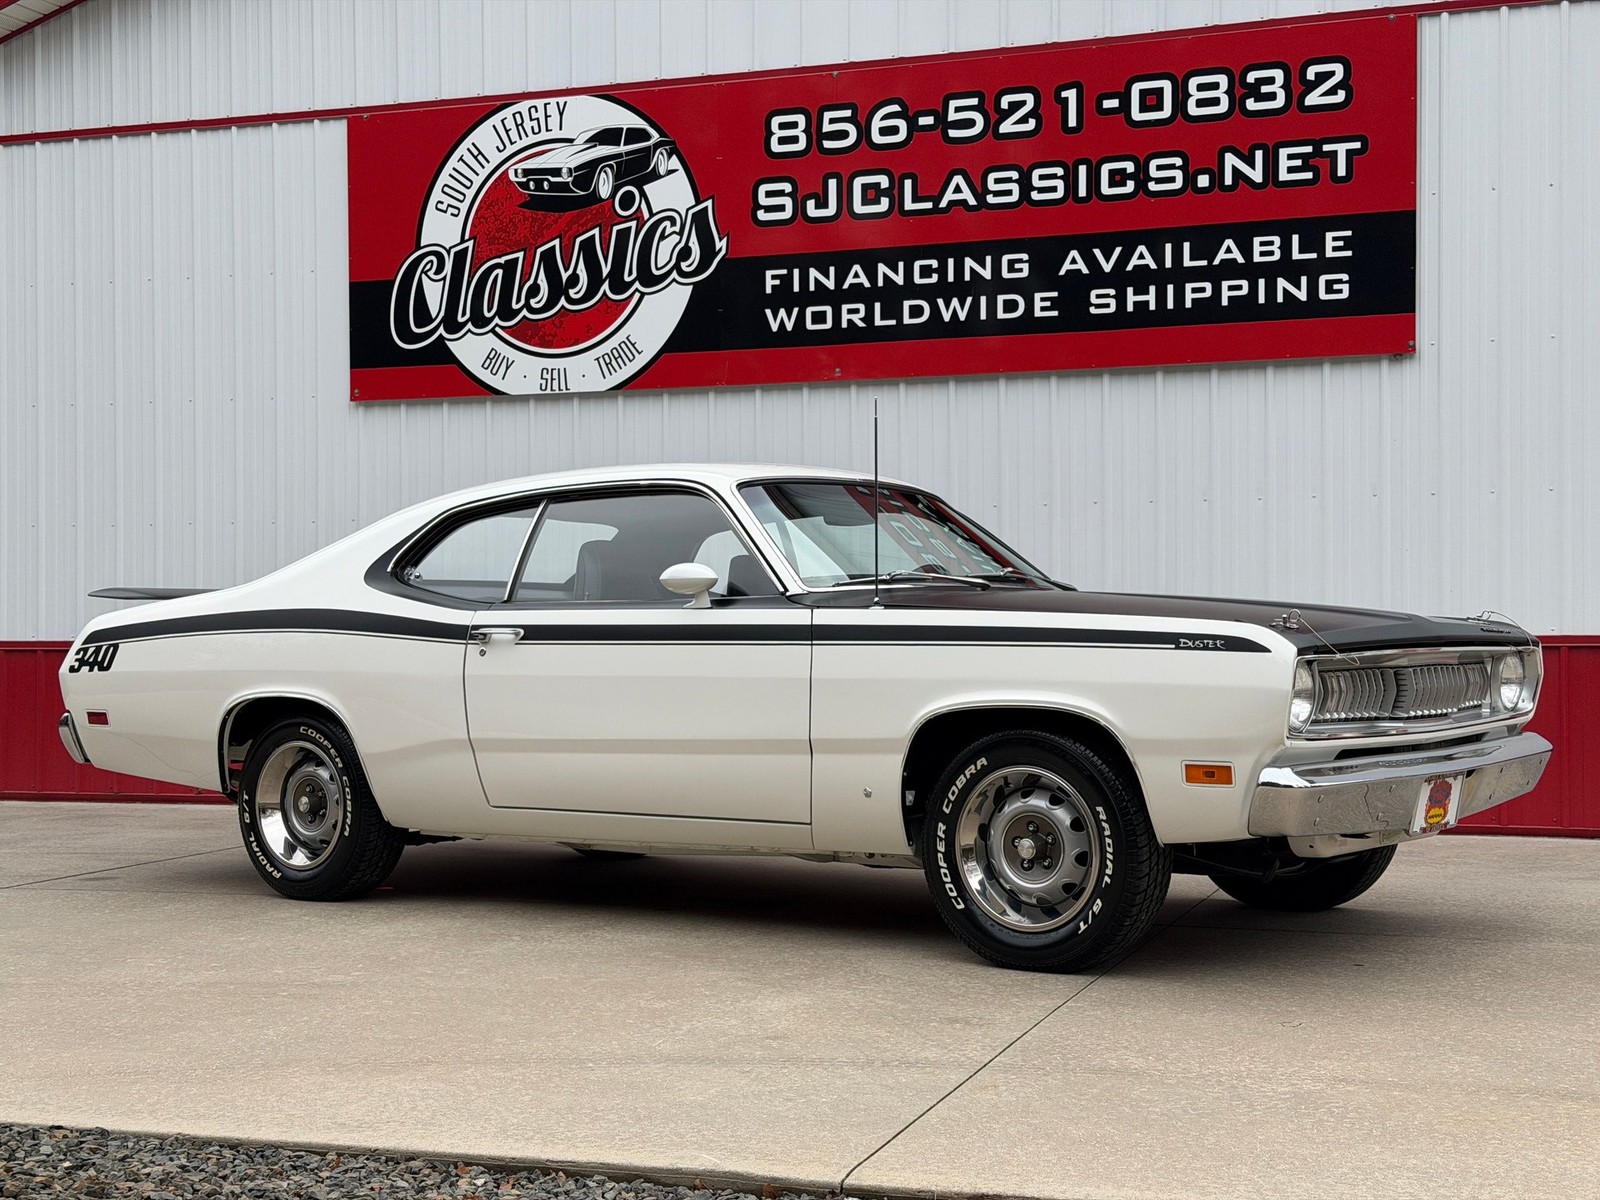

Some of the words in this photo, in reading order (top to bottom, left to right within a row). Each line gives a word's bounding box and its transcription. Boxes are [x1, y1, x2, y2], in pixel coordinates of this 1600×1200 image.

[769, 61, 1347, 153] 856-521-0832
[435, 142, 491, 218] SOUTH
[492, 100, 568, 154] JERSEY
[390, 186, 731, 350] Classics
[764, 252, 1030, 294] FINANCING
[1058, 230, 1353, 276] AVAILABLE
[764, 291, 1059, 332] WORLDWIDE
[1088, 273, 1350, 314] SHIPPING
[480, 346, 516, 381] BUY
[539, 366, 572, 392] SELL
[593, 334, 645, 380] TRADE
[68, 643, 120, 674] 340
[300, 725, 344, 769] COOPER
[342, 775, 352, 837] COBRA
[942, 757, 989, 814] COBRA
[249, 831, 283, 880] RADIAL
[936, 822, 966, 911] COOPER
[1095, 805, 1114, 889] RADIAL
[1077, 897, 1103, 936] G/T
